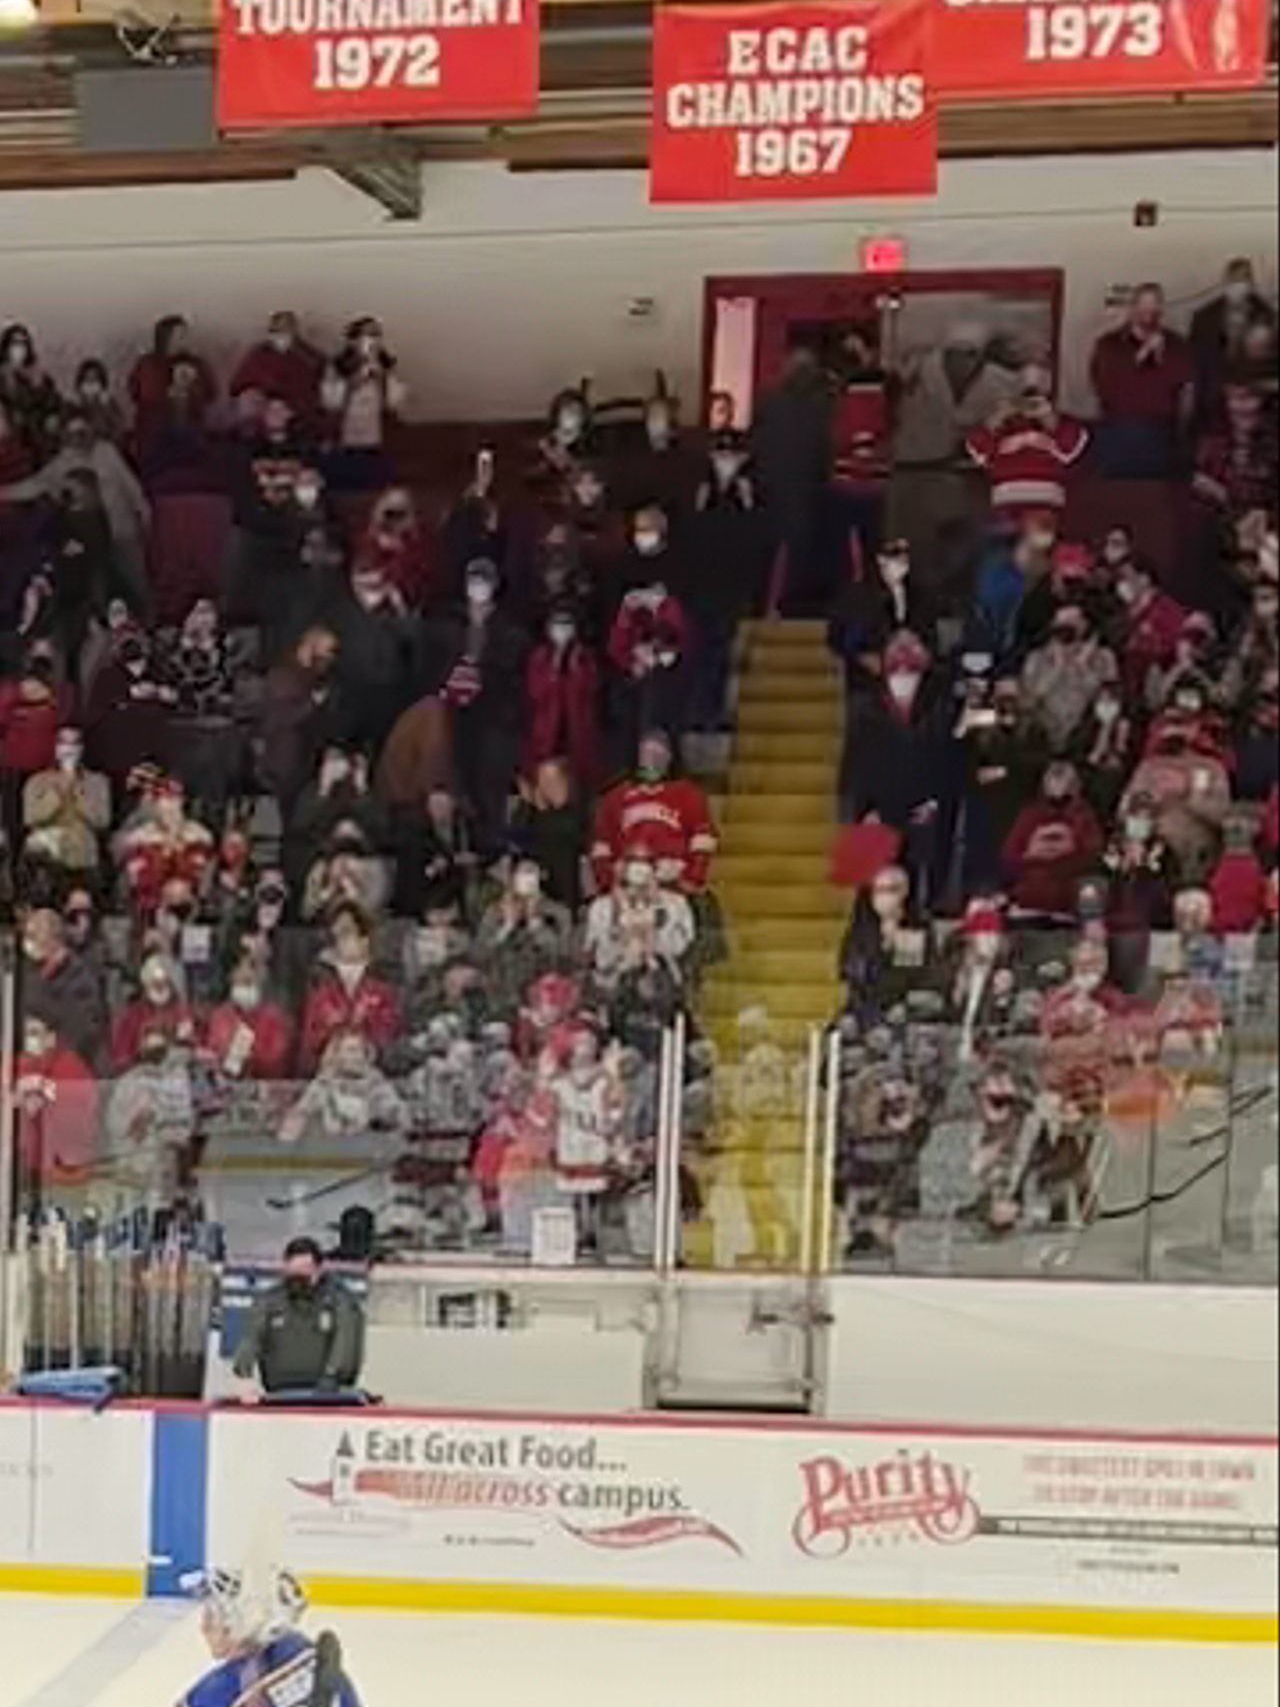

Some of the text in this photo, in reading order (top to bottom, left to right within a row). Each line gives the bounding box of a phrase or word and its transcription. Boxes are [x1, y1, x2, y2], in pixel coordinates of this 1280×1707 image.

[726, 26, 868, 75] ECAC
[1025, 2, 1163, 63] 1973
[312, 35, 440, 90] 1972
[666, 74, 924, 129] CHAMPIONS
[733, 129, 851, 176] 1967
[366, 1430, 628, 1474] Eat Great Food...
[454, 1477, 549, 1507] across
[556, 1482, 691, 1517] campus.
[799, 1450, 972, 1536] Purity
